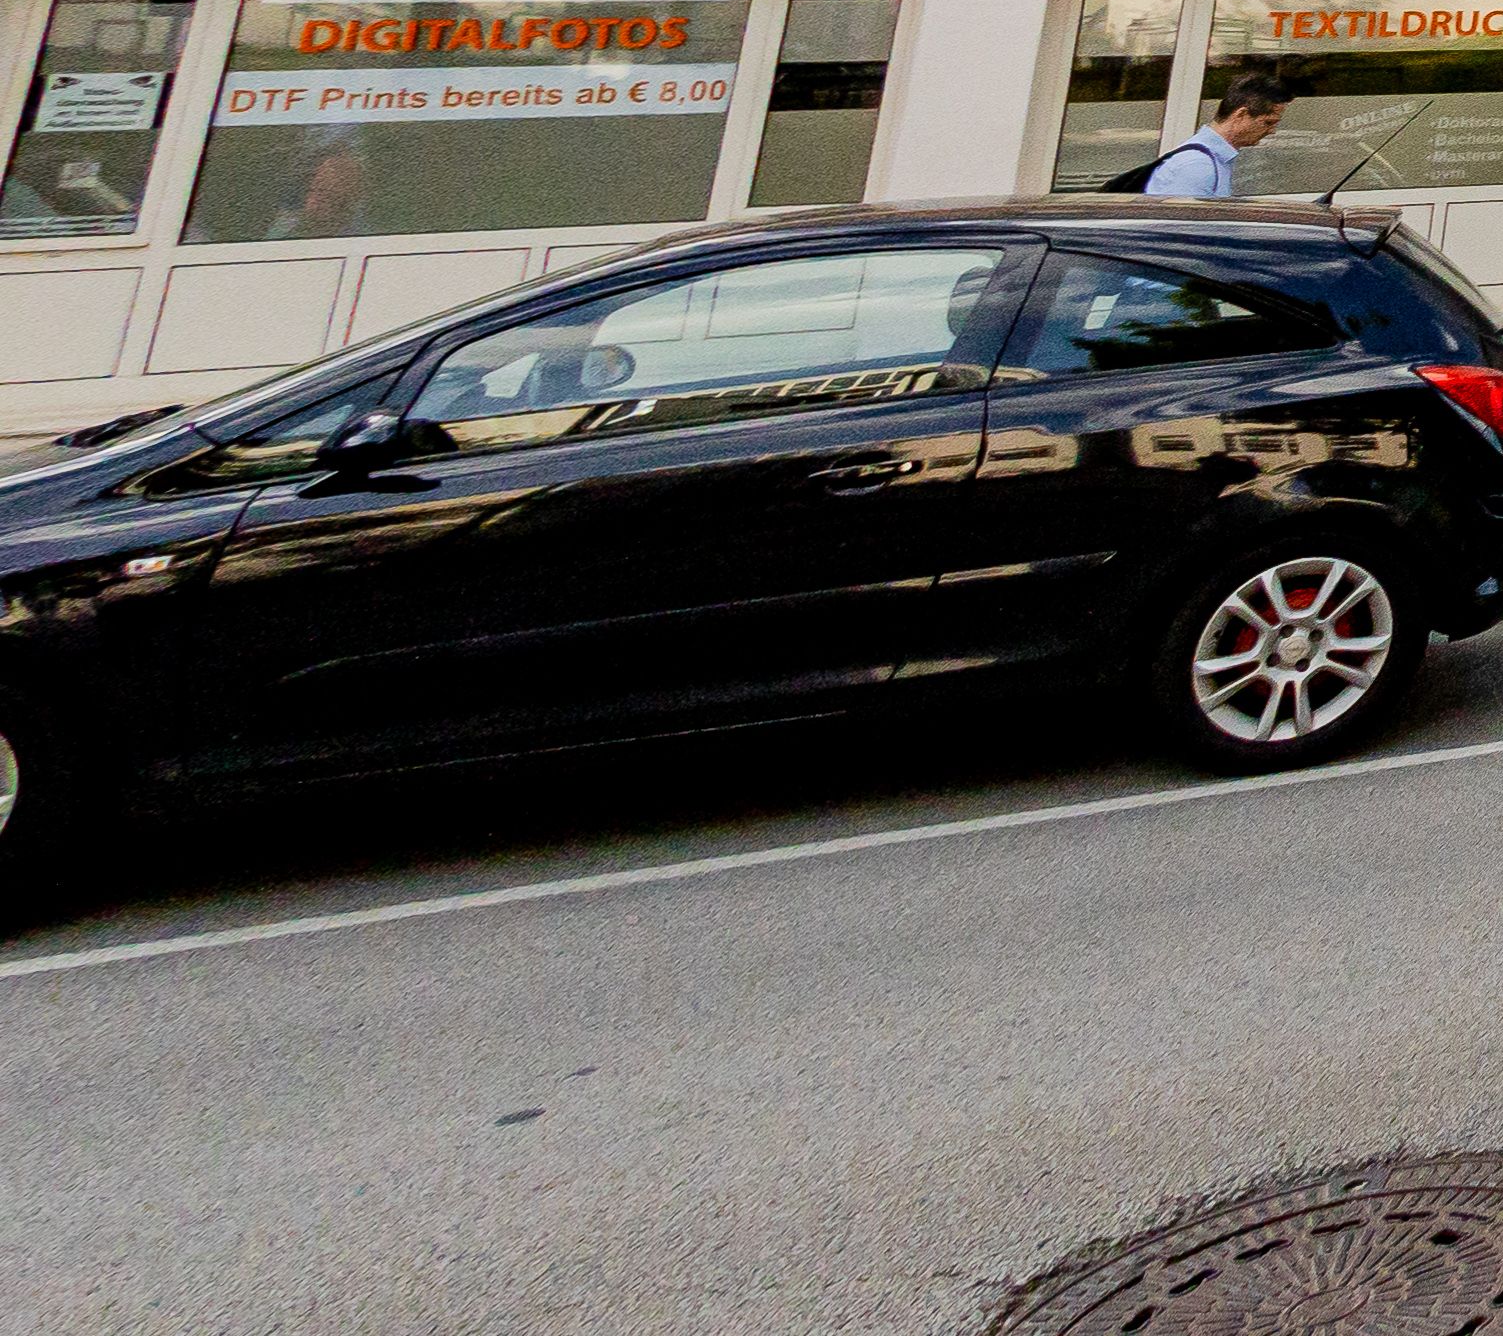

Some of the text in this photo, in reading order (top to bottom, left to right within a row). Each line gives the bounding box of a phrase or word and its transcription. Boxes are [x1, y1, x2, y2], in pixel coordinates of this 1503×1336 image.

[298, 17, 691, 55] DIGITALFOTOS
[228, 79, 728, 113] DTF Prints bereits ab € 8,00
